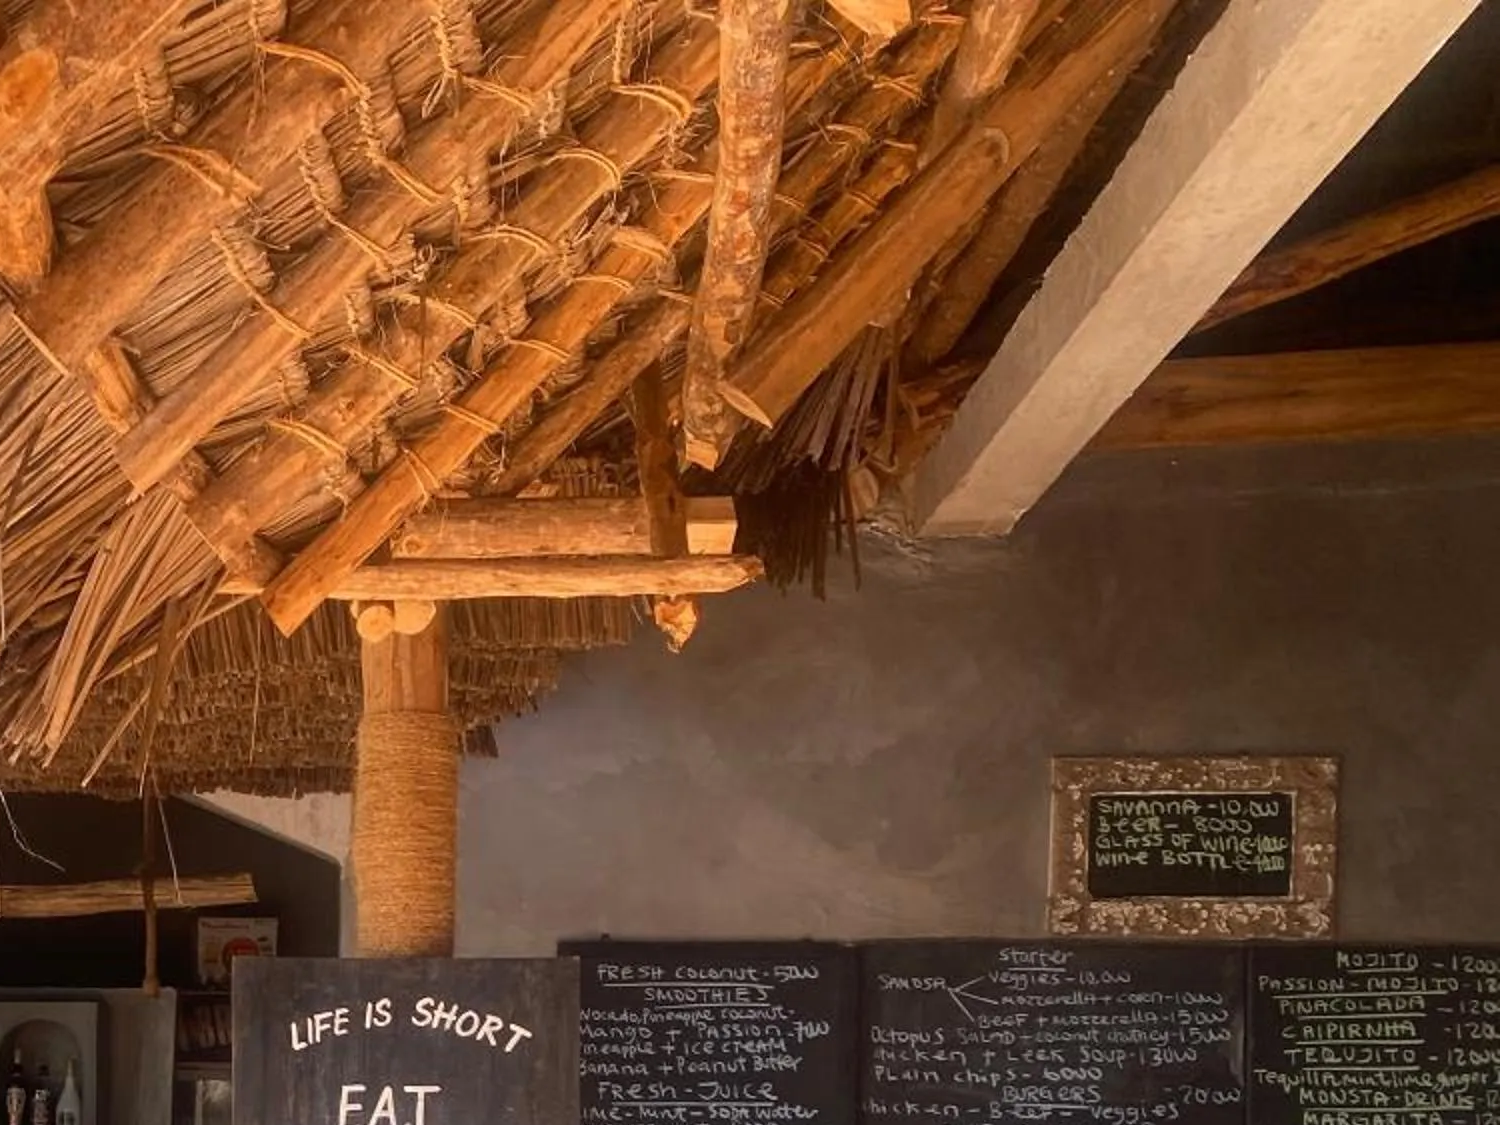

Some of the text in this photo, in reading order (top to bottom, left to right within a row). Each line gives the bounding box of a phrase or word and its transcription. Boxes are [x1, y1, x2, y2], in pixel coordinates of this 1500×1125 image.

[1095, 834, 1164, 850] GLASS
[1171, 833, 1194, 849] OF
[1336, 951, 1419, 971] MOJITO
[643, 987, 769, 1003] SMOOTHIES
[290, 997, 532, 1053] LIFE IS SHORT
